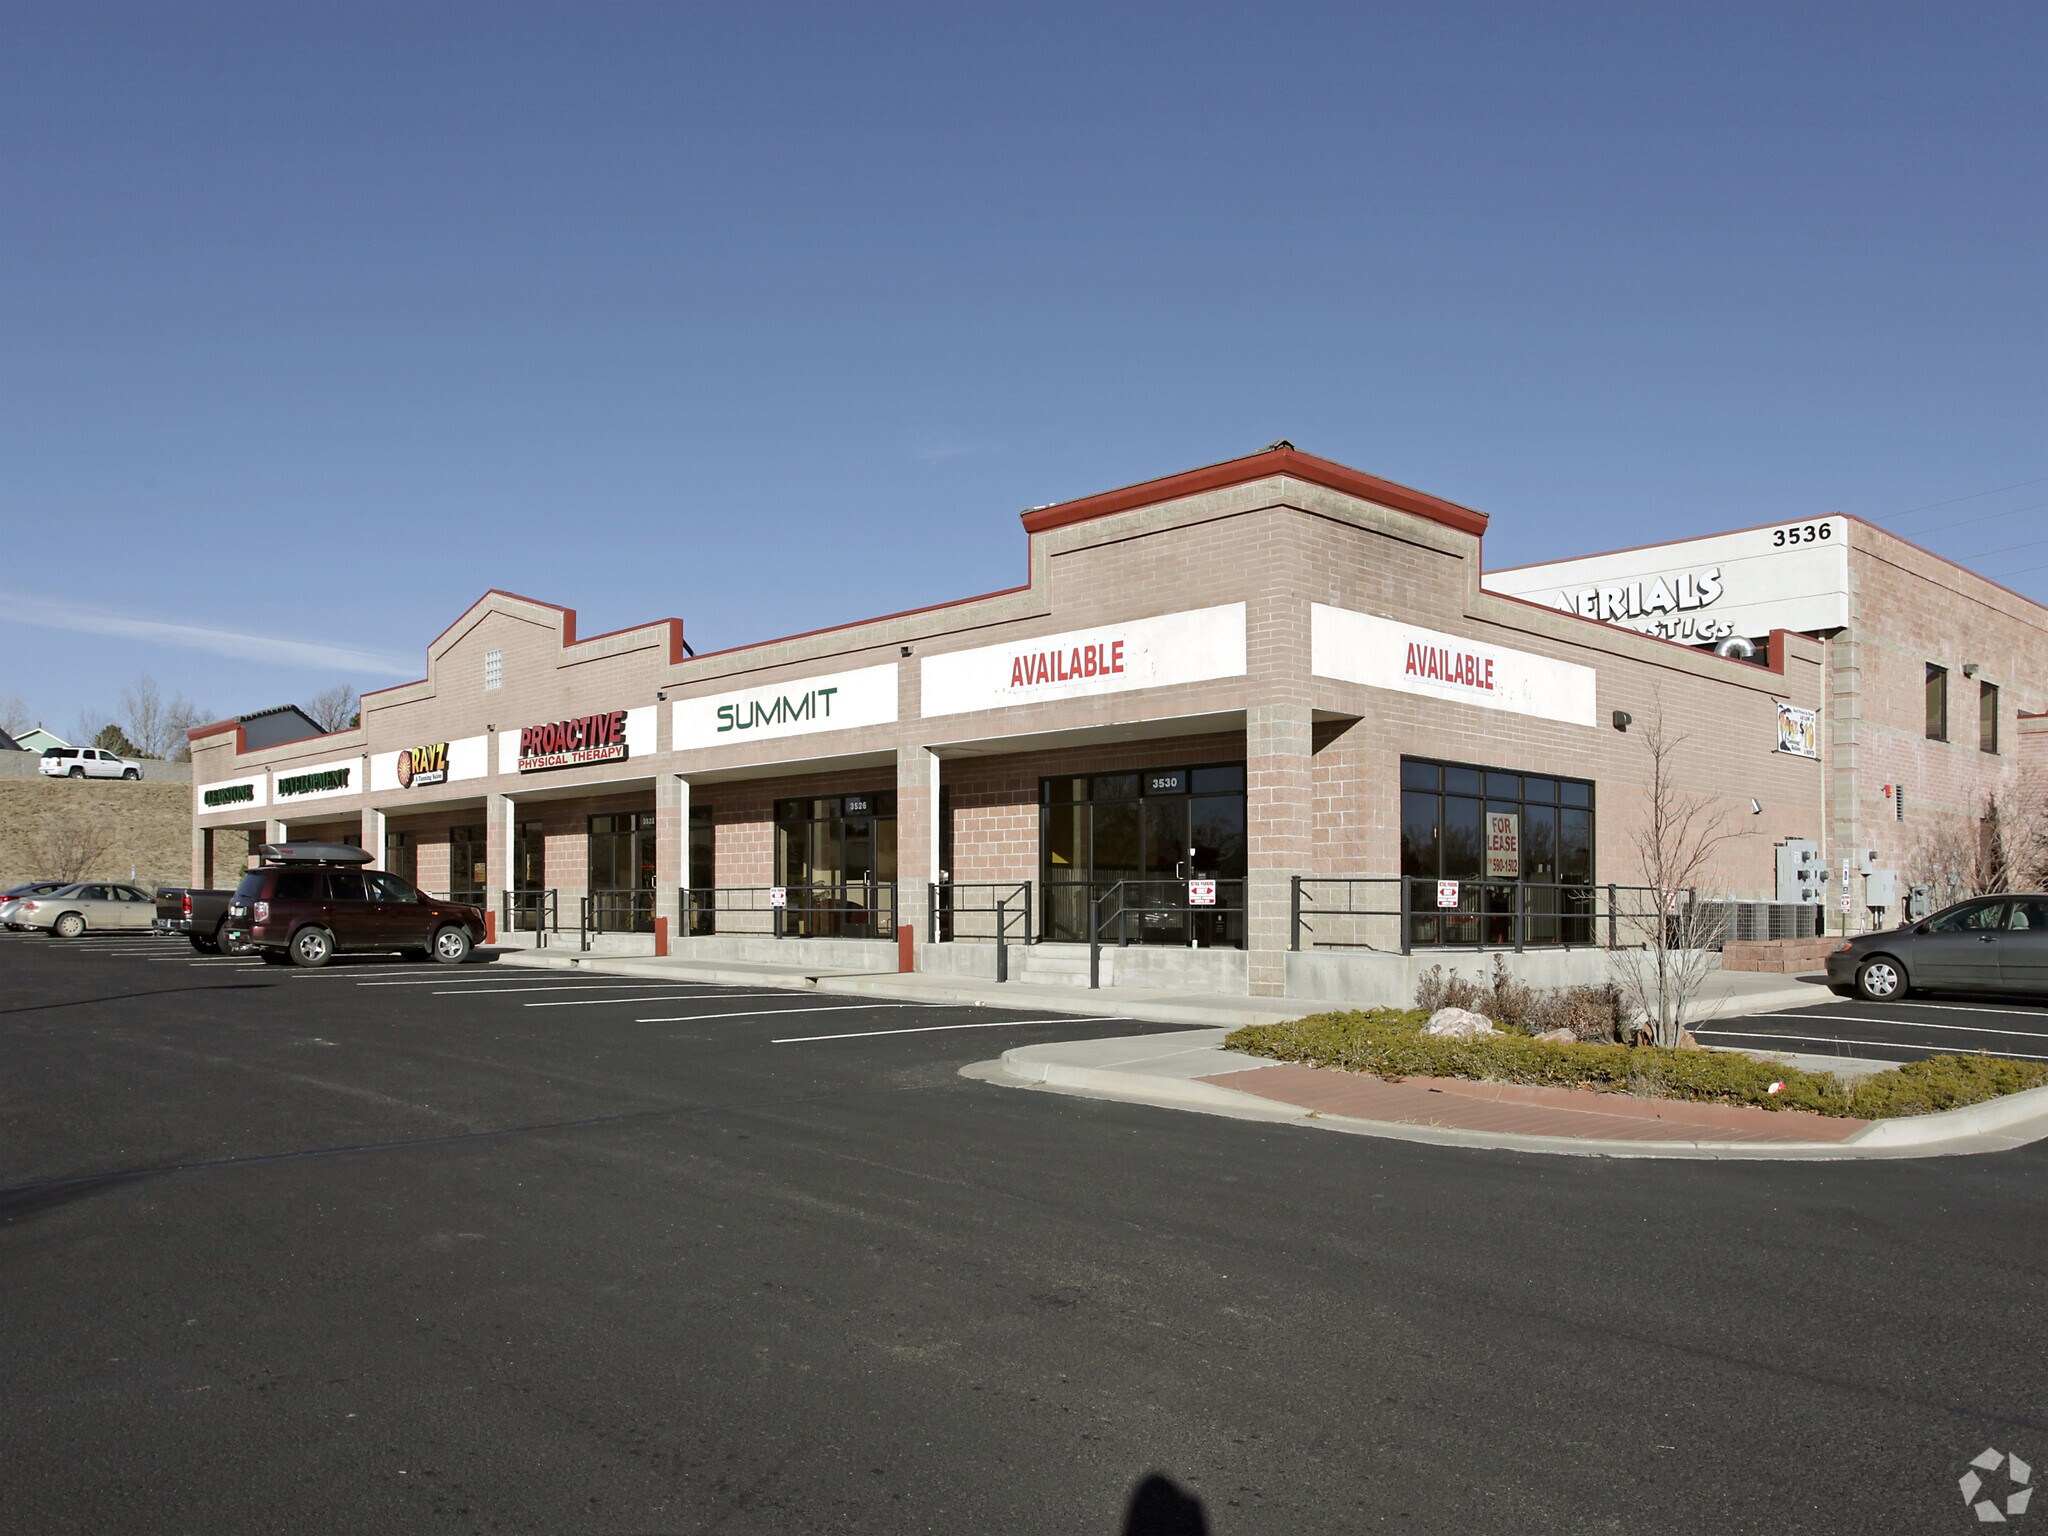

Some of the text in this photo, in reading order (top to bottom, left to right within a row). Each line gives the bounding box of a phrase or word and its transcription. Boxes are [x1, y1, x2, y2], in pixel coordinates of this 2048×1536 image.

[1773, 522, 1831, 547] 3536
[1010, 640, 1124, 688] AVAILABLE
[1405, 642, 1494, 690] AVAILABLE
[717, 687, 838, 732] SUMMIT
[519, 710, 627, 757] PROACTIVE
[411, 742, 447, 774] RAYZ
[518, 745, 623, 770] PHYSICAL THERAPY
[278, 768, 350, 797] DEVELOPMENT
[1152, 777, 1178, 789] 3530
[850, 801, 867, 810] 3526
[1492, 817, 1511, 833] FOR
[1487, 835, 1517, 851] LEASE
